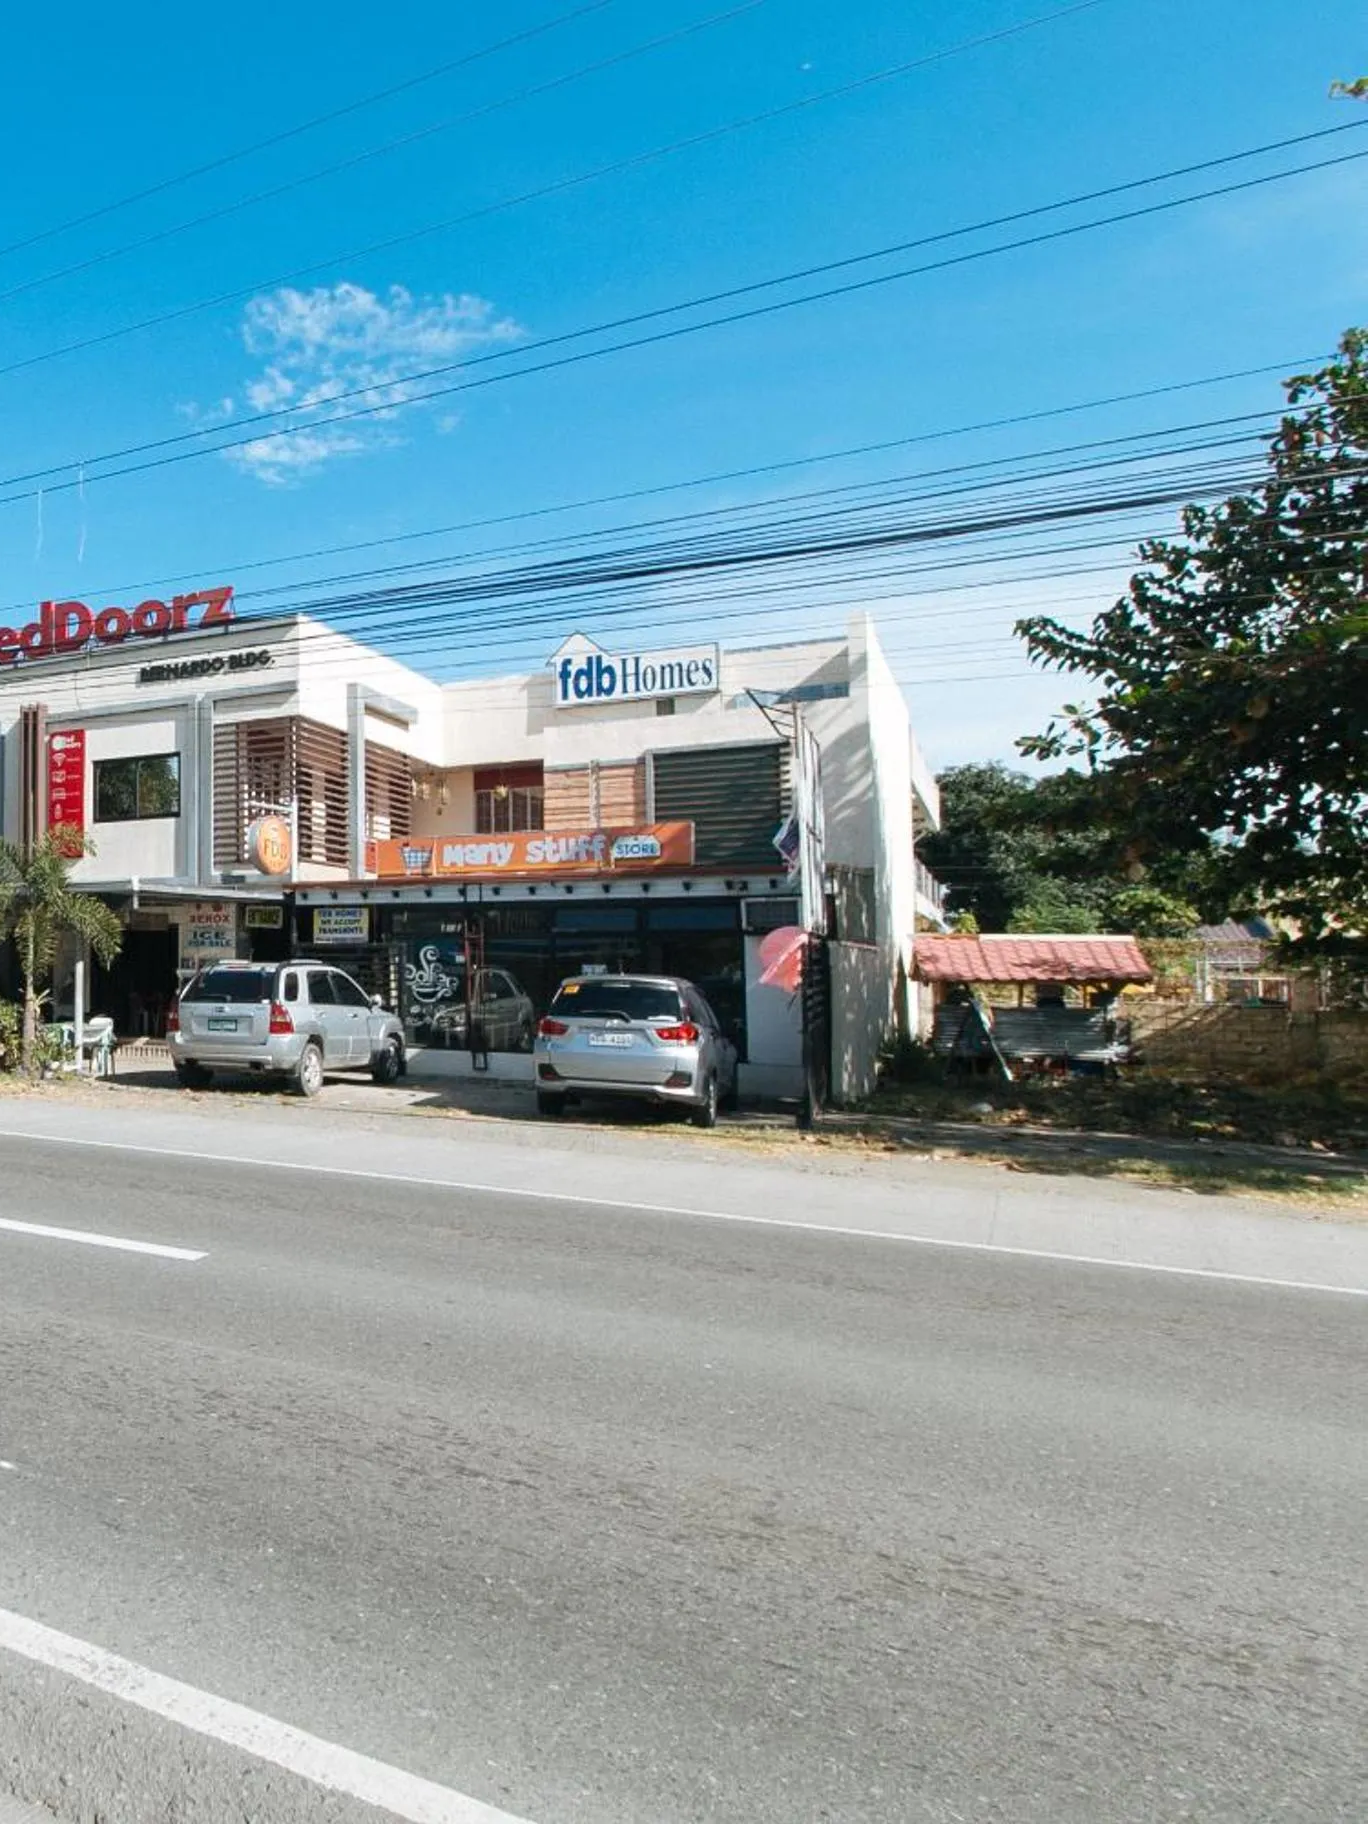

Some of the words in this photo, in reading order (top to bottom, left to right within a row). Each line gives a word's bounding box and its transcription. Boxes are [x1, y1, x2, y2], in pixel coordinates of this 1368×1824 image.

[559, 655, 617, 701] fdb
[620, 656, 713, 694] Homes
[615, 842, 658, 857] STORE
[189, 914, 230, 923] XEROX
